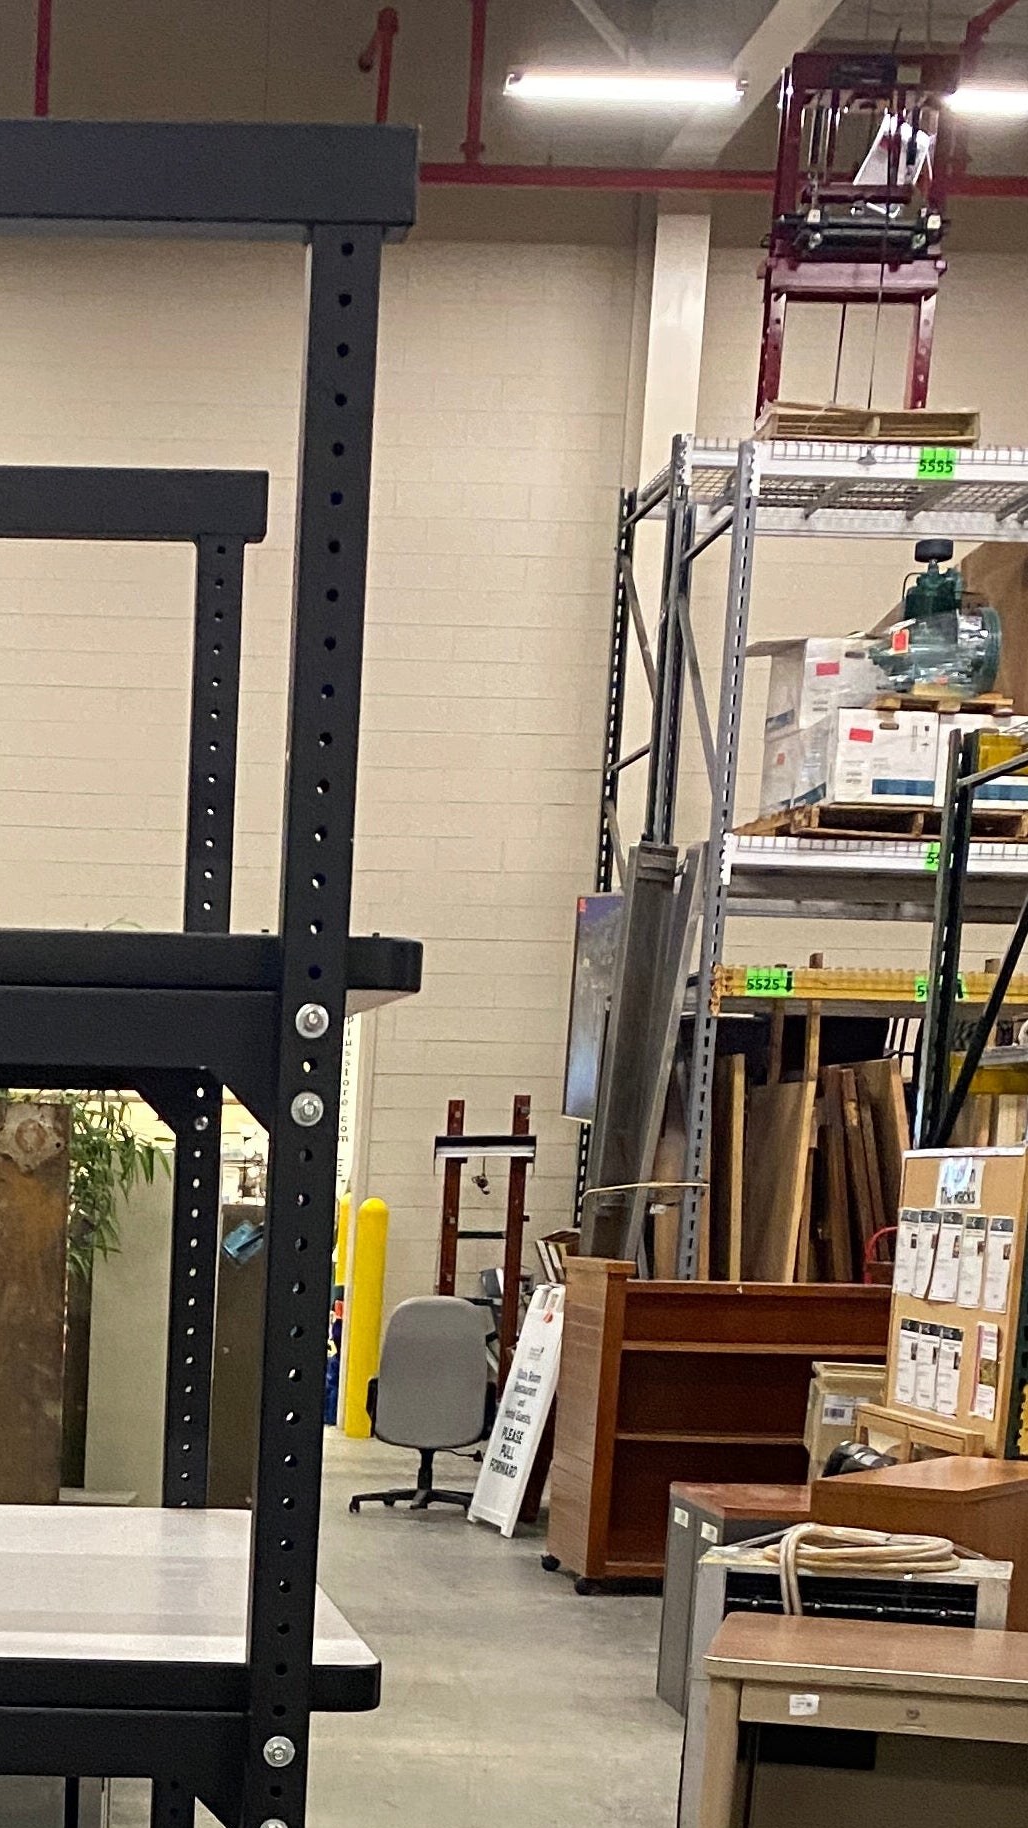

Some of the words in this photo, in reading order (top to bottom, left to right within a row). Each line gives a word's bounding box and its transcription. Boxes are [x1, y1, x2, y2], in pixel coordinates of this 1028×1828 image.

[918, 459, 953, 473] 5555
[747, 978, 780, 990] 5525
[501, 1426, 524, 1445] PLEASE
[500, 1443, 515, 1461] PULL
[490, 1457, 518, 1479] FORWARD
